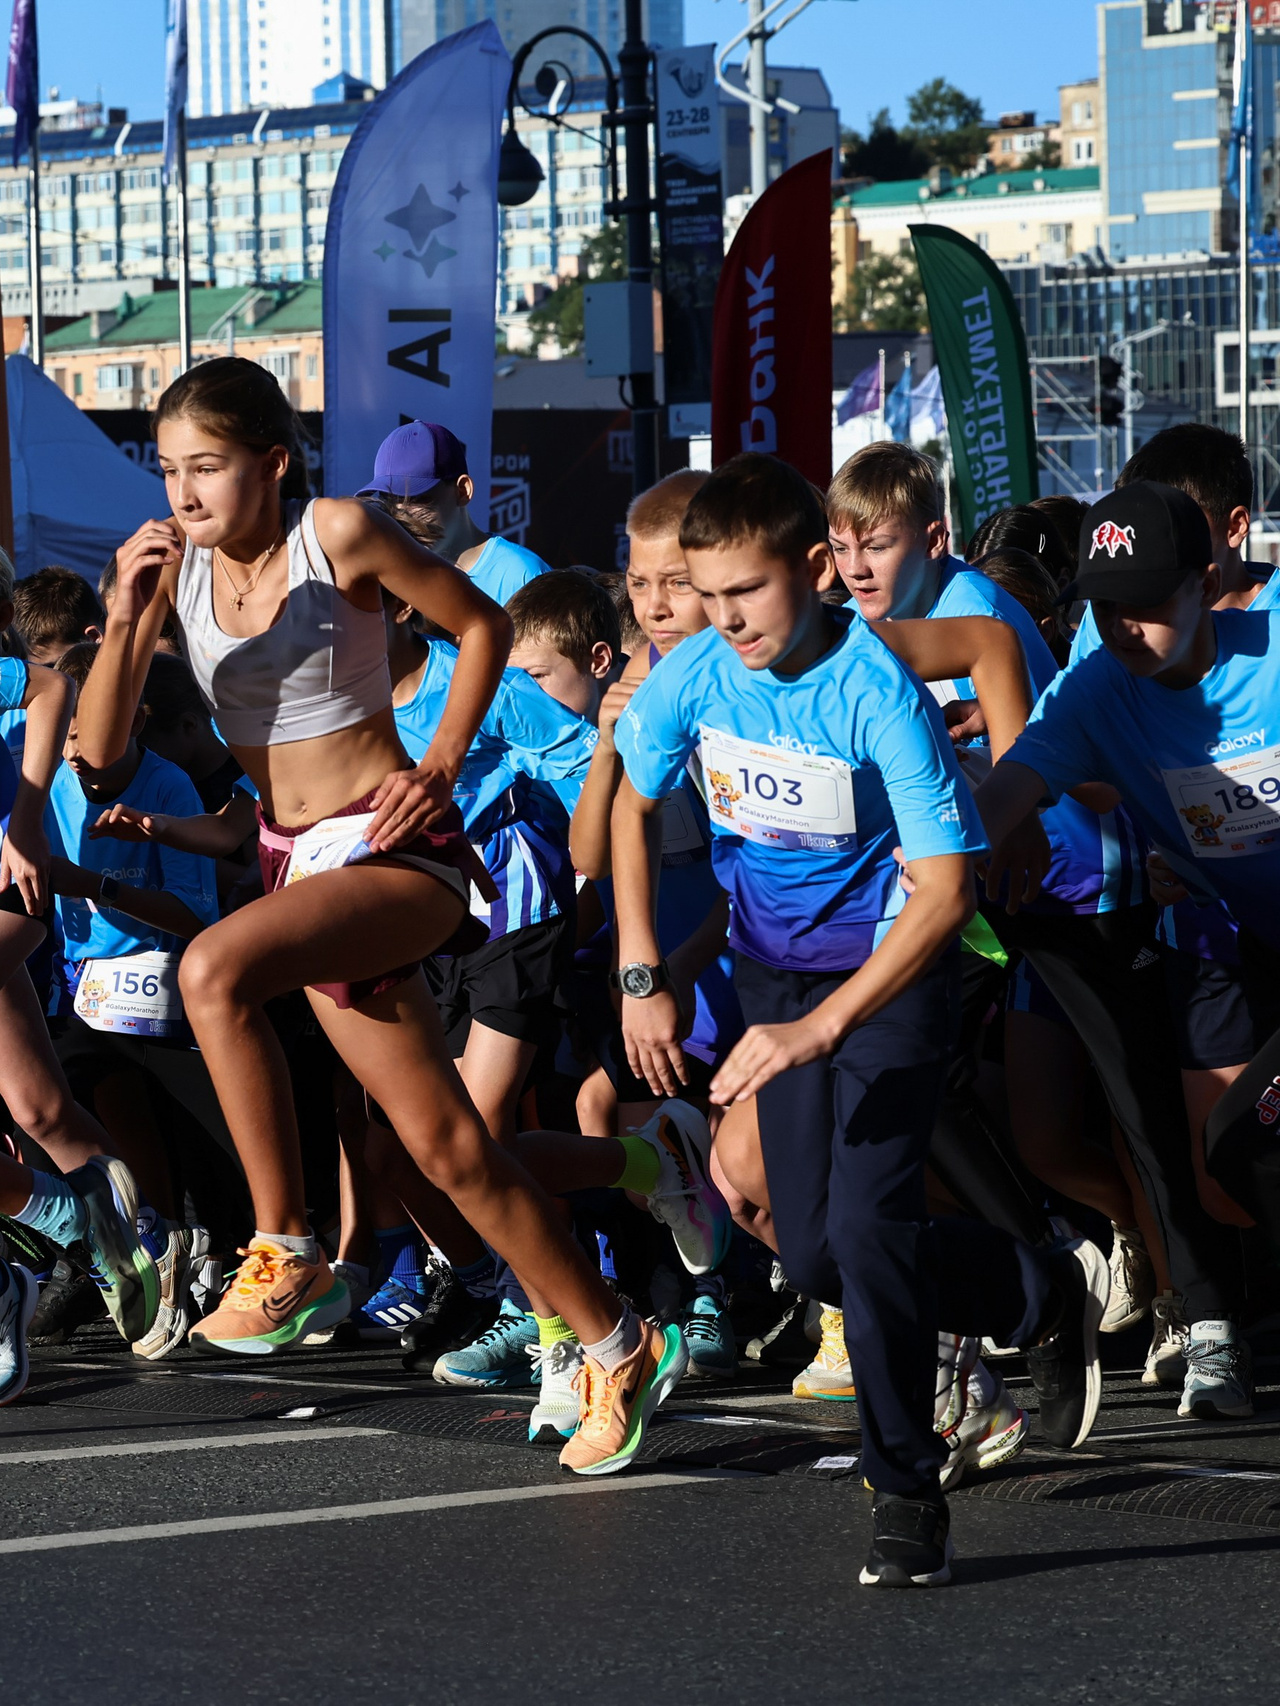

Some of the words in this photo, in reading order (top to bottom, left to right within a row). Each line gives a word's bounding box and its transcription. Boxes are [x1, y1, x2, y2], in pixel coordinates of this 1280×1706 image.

[666, 107, 709, 126] 23-28
[387, 309, 452, 388] AI
[1204, 729, 1265, 756] Galaxy
[738, 768, 803, 806] 103
[1214, 777, 1280, 814] 189
[738, 805, 810, 828] #GalaxyMarathon
[1132, 953, 1160, 970] adidas
[112, 970, 159, 997] 156
[105, 1003, 160, 1015] #GalaxyMarathon
